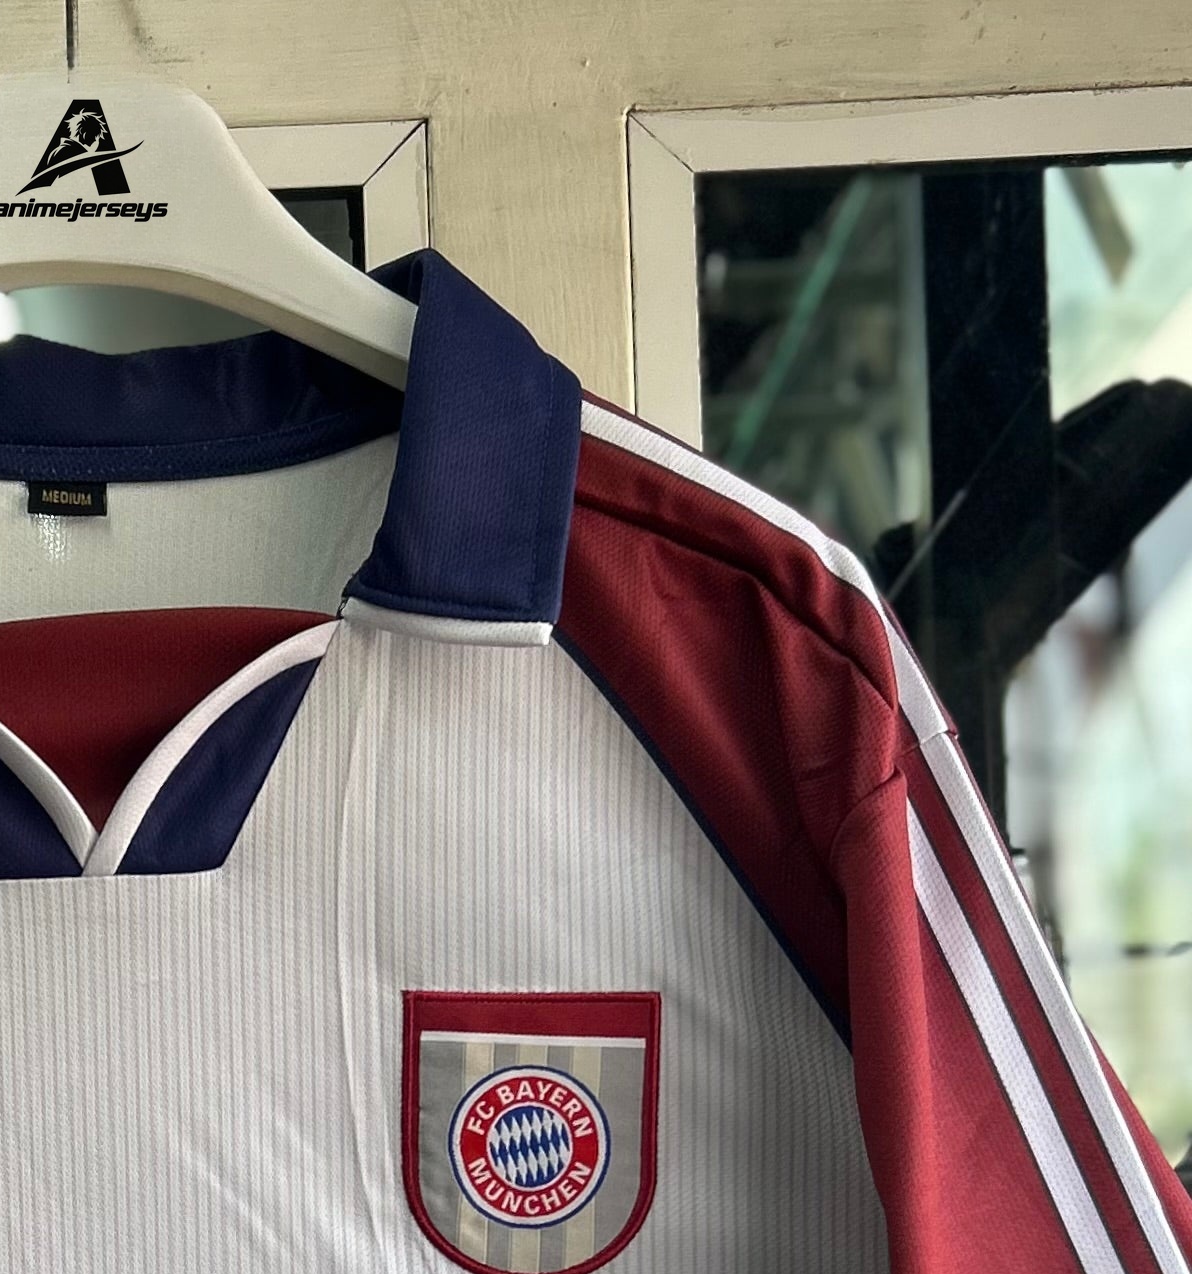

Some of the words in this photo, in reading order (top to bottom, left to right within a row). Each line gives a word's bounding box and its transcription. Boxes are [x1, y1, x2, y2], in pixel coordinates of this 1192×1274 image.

[41, 489, 92, 506] MEDIUM
[467, 1101, 495, 1136] FC
[496, 1080, 593, 1138] BAYERN
